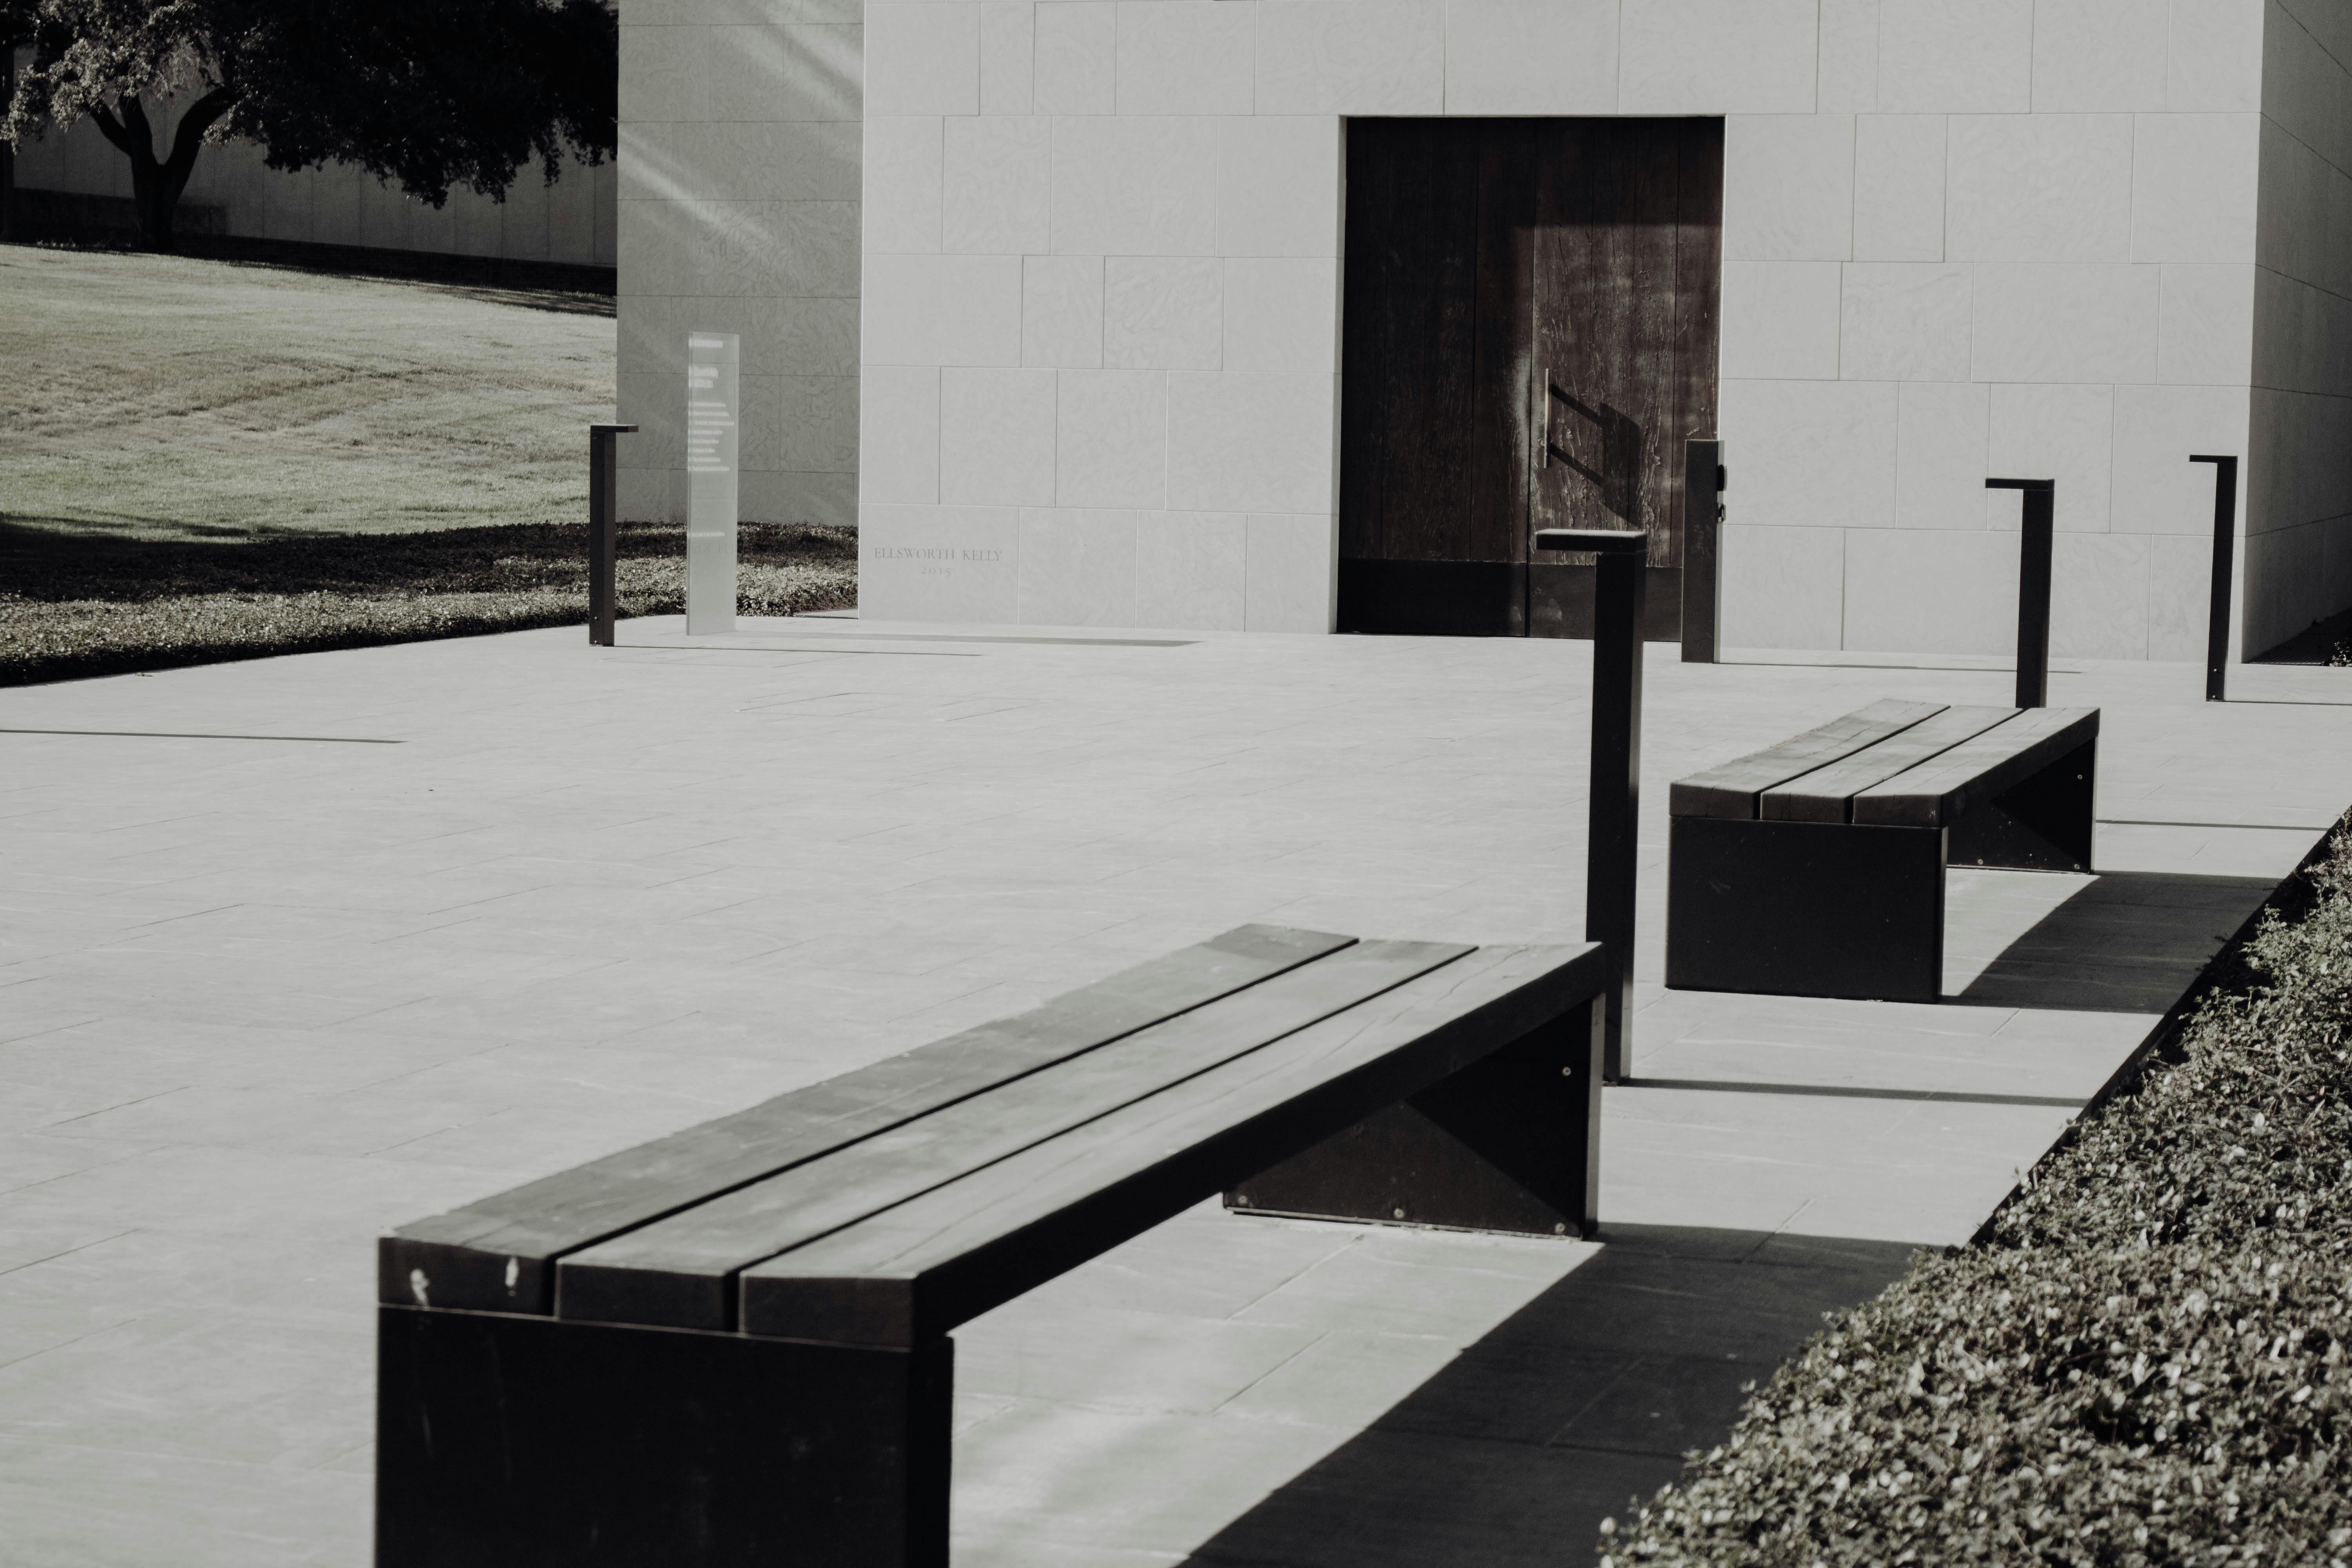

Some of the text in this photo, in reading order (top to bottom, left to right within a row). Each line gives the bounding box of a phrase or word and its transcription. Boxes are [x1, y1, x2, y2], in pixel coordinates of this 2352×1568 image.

[875, 547, 1003, 561] ELLSWORTH KELLY
[922, 567, 951, 577] 2015
